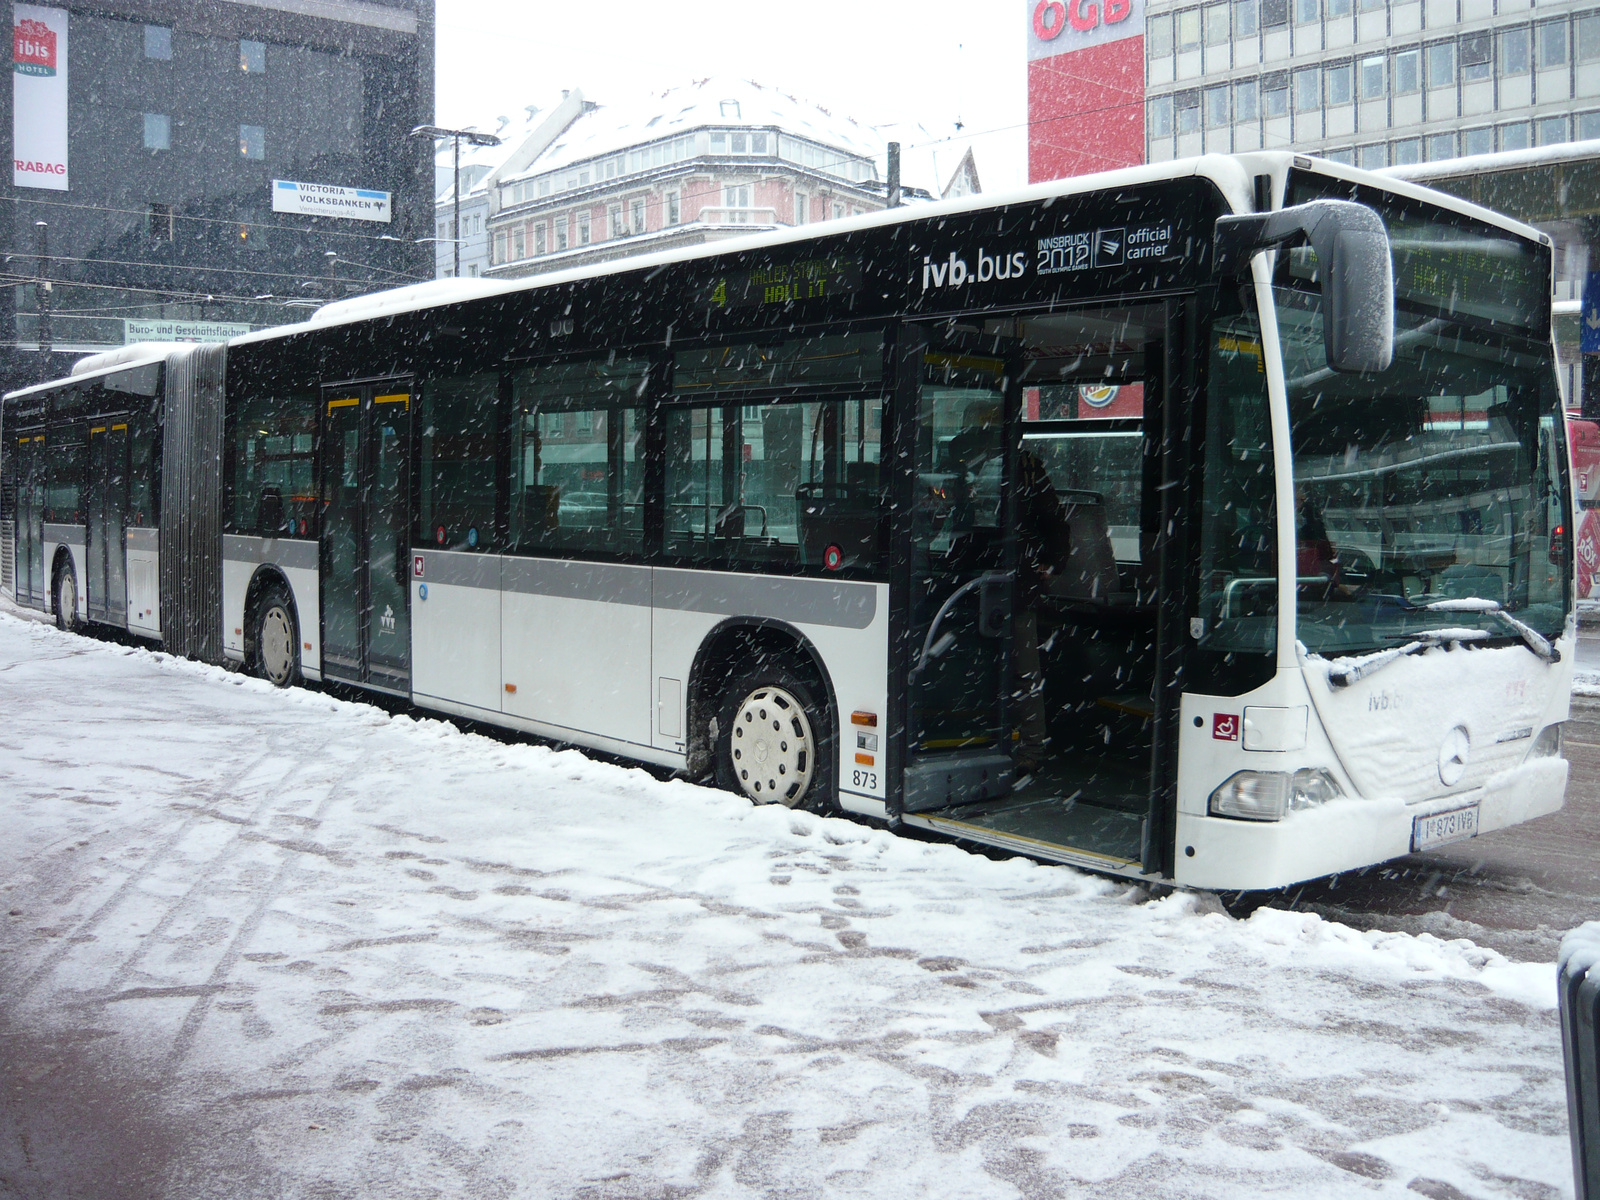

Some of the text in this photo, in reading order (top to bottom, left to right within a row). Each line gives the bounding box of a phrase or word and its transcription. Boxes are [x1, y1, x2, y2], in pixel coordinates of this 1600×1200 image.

[19, 40, 49, 58] ibis
[18, 65, 49, 75] HOTEL
[300, 184, 345, 195] VICTORIA
[300, 195, 371, 209] VOLKSBANKEN
[1038, 232, 1090, 251] INNSBRUCK
[1127, 225, 1171, 244] official
[1037, 244, 1089, 269] 2012
[1126, 242, 1168, 260] carrier
[922, 247, 1026, 291] ivb.bus
[712, 278, 727, 308] 4
[764, 283, 802, 304] HALL
[129, 323, 247, 338] Büro- und Geschäftsflächen
[853, 769, 877, 790] 873
[1436, 815, 1455, 836] 873
